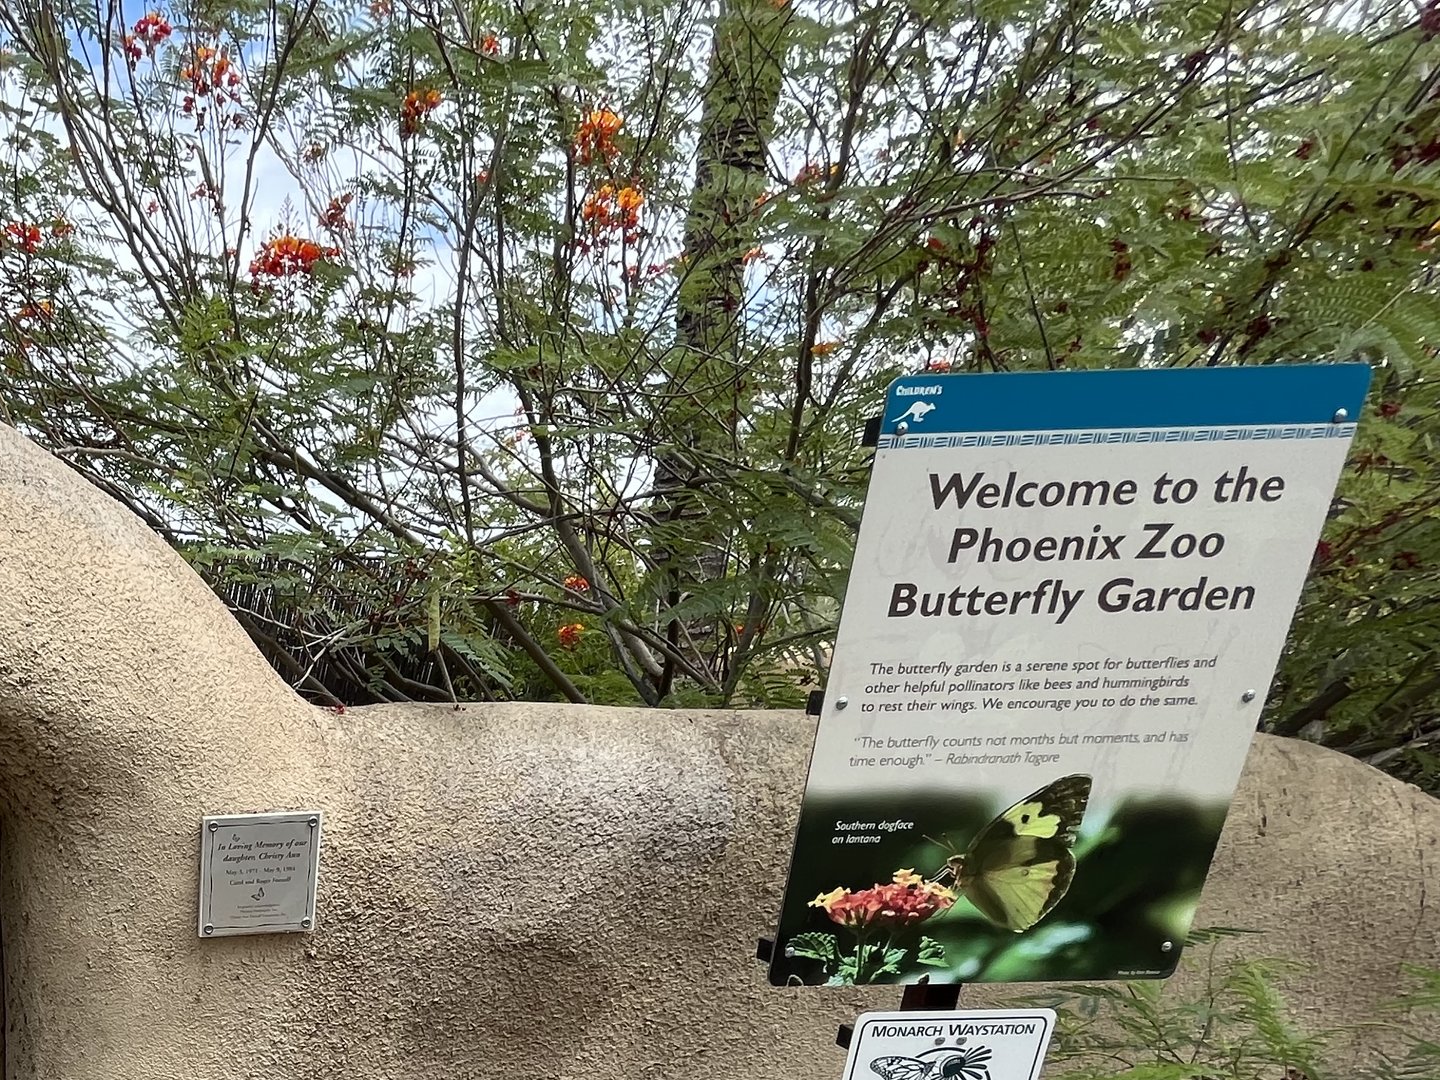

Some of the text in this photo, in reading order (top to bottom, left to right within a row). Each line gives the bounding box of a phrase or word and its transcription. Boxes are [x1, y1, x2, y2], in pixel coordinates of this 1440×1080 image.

[928, 465, 1286, 510] Welcome to the
[947, 522, 1226, 563] Phoenix Zoo
[887, 576, 1256, 625] Butterfly Garden
[870, 655, 1218, 677] The butterfly garden is a serene spot for butterflies and
[865, 675, 1190, 696] other helpful pollinators like bees and hummingbirds
[861, 694, 1198, 713] to rest their wings. We encourage you to do the same.
[887, 735, 940, 750] butterfly
[942, 736, 982, 747] counts
[986, 736, 1007, 746] not
[1010, 733, 1055, 746] months
[1059, 733, 1079, 745] but
[1082, 733, 1140, 745] moments,
[1143, 731, 1166, 744] and
[1169, 731, 1189, 743] has
[849, 755, 876, 767] time
[946, 752, 1021, 765] Rabindranath
[1024, 751, 1060, 766] Tagore
[835, 819, 914, 832] Southern dogface
[217, 843, 226, 851] In
[228, 842, 253, 851] Loving
[255, 841, 284, 849] Memory
[285, 838, 295, 849] of
[831, 834, 882, 844] on lantana
[286, 851, 301, 859] Ann
[872, 1024, 1036, 1037] MONARCH WAYSTATION
